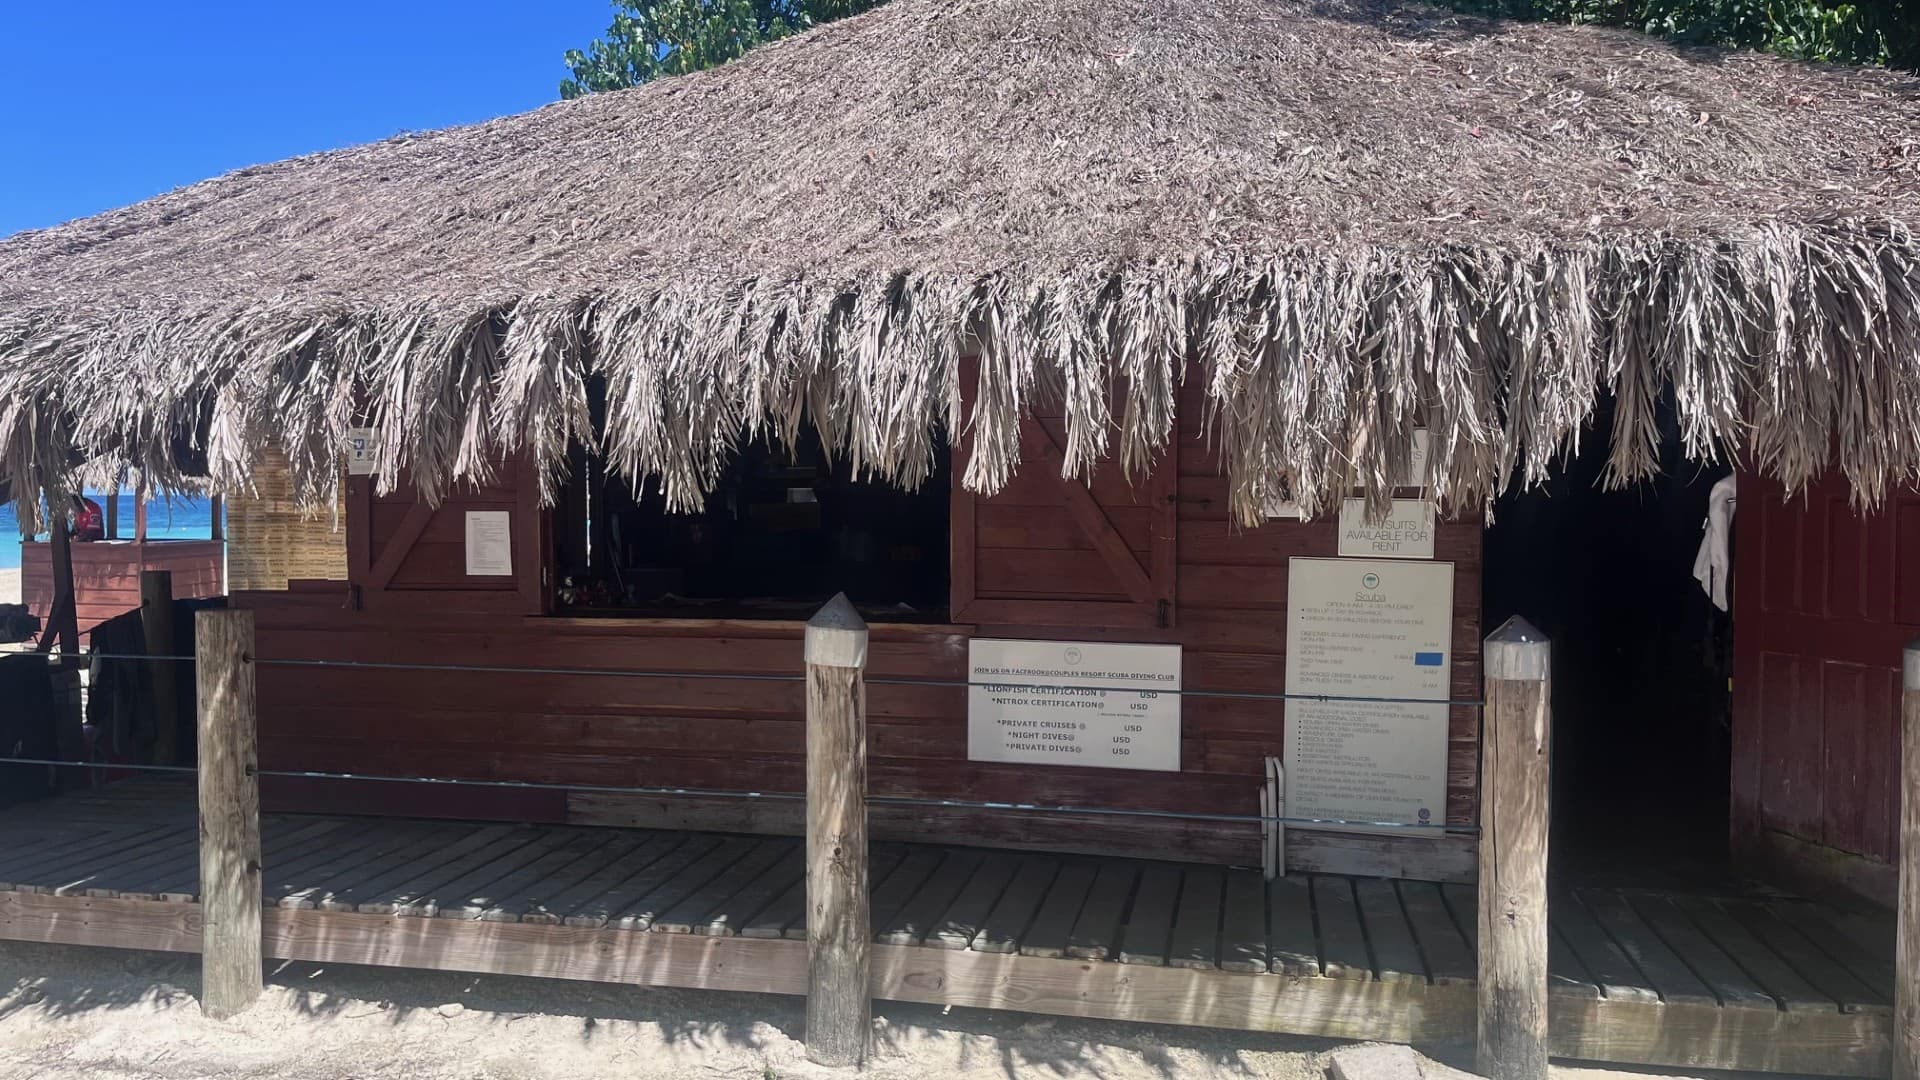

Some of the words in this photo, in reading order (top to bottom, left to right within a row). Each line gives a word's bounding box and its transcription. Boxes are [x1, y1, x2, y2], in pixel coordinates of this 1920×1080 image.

[1405, 531, 1428, 541] FOR
[1372, 541, 1400, 552] RENT
[1355, 591, 1386, 602] Scuba
[1030, 686, 1097, 696] CERTIFICATION
[1139, 690, 1158, 699] USD
[1130, 703, 1148, 711] USD
[1040, 720, 1076, 729] CRUISES
[1124, 724, 1142, 732] USD
[1112, 735, 1130, 744] USD
[1112, 747, 1130, 756] USD
